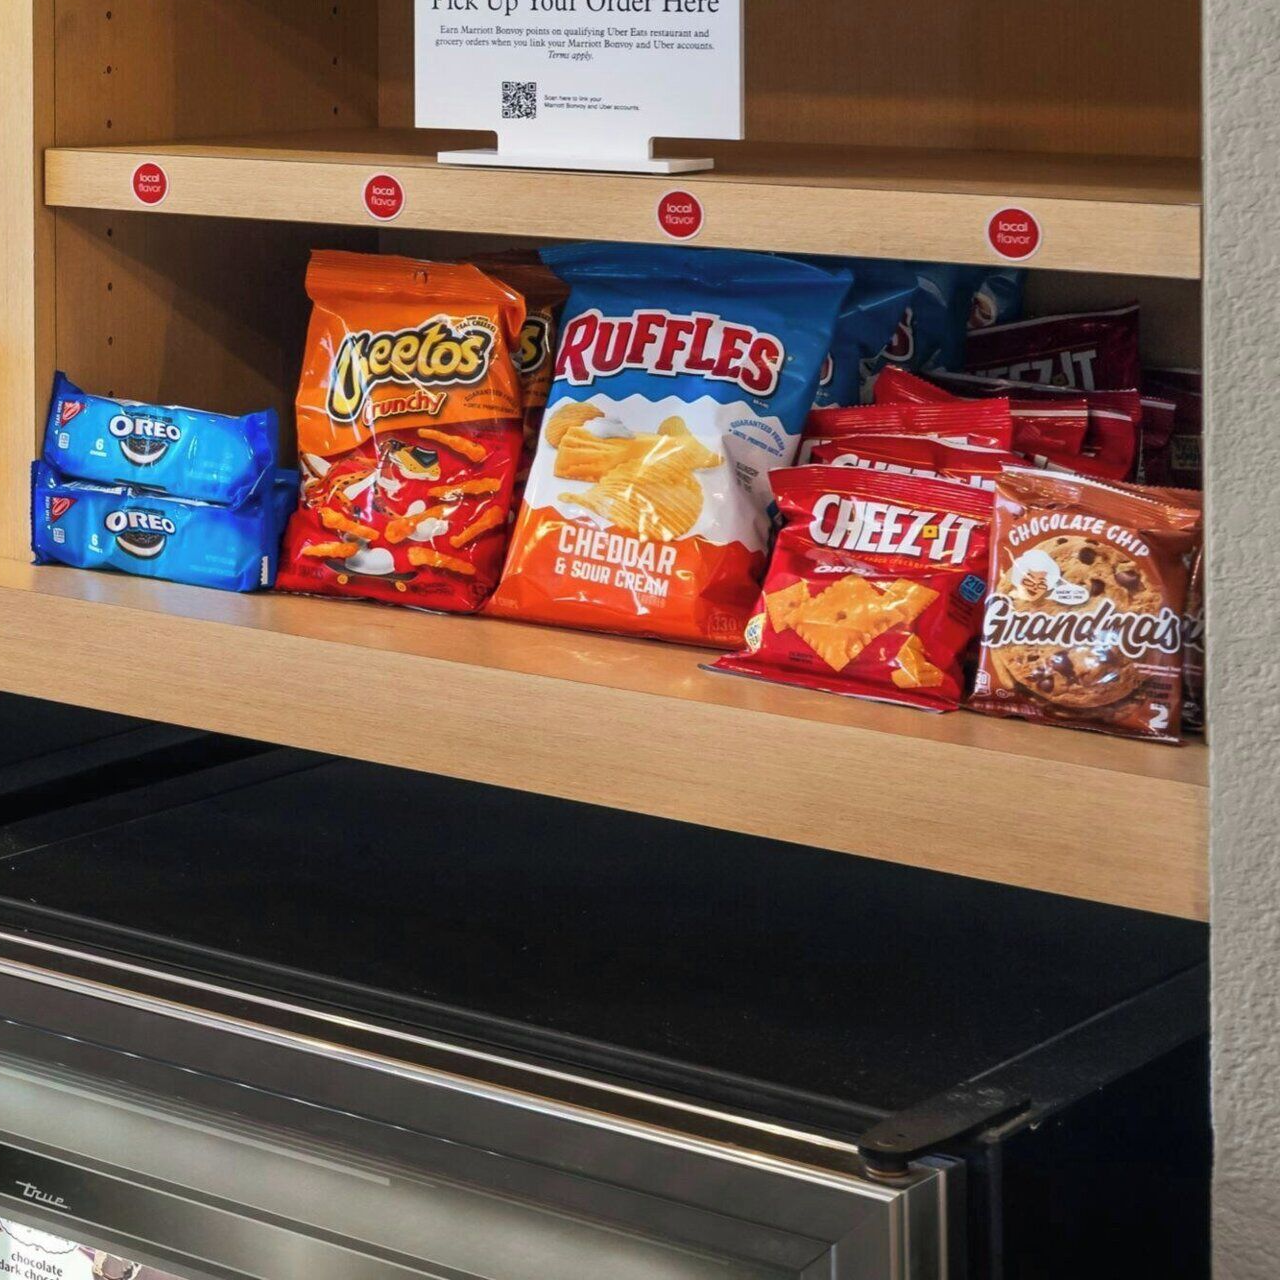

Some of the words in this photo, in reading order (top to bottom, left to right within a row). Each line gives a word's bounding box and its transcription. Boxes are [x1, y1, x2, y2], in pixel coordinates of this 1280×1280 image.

[434, 39, 464, 49] grocery
[465, 37, 490, 48] orders
[491, 37, 512, 47] when
[513, 39, 528, 49] you
[529, 37, 546, 48] link
[547, 40, 566, 50] your
[568, 38, 602, 49] Marriott
[604, 38, 634, 51] Bonvoy
[635, 39, 652, 50] and
[653, 39, 675, 50] Uber
[676, 40, 715, 51] accounts.
[440, 25, 459, 35] Earn
[460, 25, 494, 35] Marriott
[495, 25, 525, 37] Bonvoy
[526, 26, 550, 38] points
[564, 26, 606, 39] qualifying
[608, 26, 628, 37] Uber
[630, 27, 648, 37] Eats
[650, 28, 691, 38] restaurant
[693, 27, 710, 38] and
[547, 50, 570, 60] Terms
[571, 50, 594, 61] apply.
[138, 183, 161, 193] flavor
[140, 173, 160, 182] local
[370, 196, 396, 207] flavor
[372, 186, 395, 196] local
[665, 214, 695, 224] flavor
[666, 203, 692, 213] local
[998, 220, 1028, 232] local
[996, 232, 1031, 245] flavor
[554, 312, 781, 393] RUFFLES
[332, 323, 488, 414] Cheetos
[366, 391, 446, 425] Crunchy
[108, 413, 182, 441] OREO
[104, 510, 176, 534] OREO
[1008, 513, 1107, 546] CHOCOLATE
[1106, 524, 1150, 557] CHIP
[557, 525, 677, 577] CHEDDAR
[554, 557, 566, 575] &
[569, 560, 612, 587] SOUR
[613, 568, 670, 598] CREAM
[986, 599, 1180, 657] Grandma's
[1149, 703, 1170, 729] 2
[15, 1179, 70, 1210] true
[10, 1251, 64, 1277] chocolate
